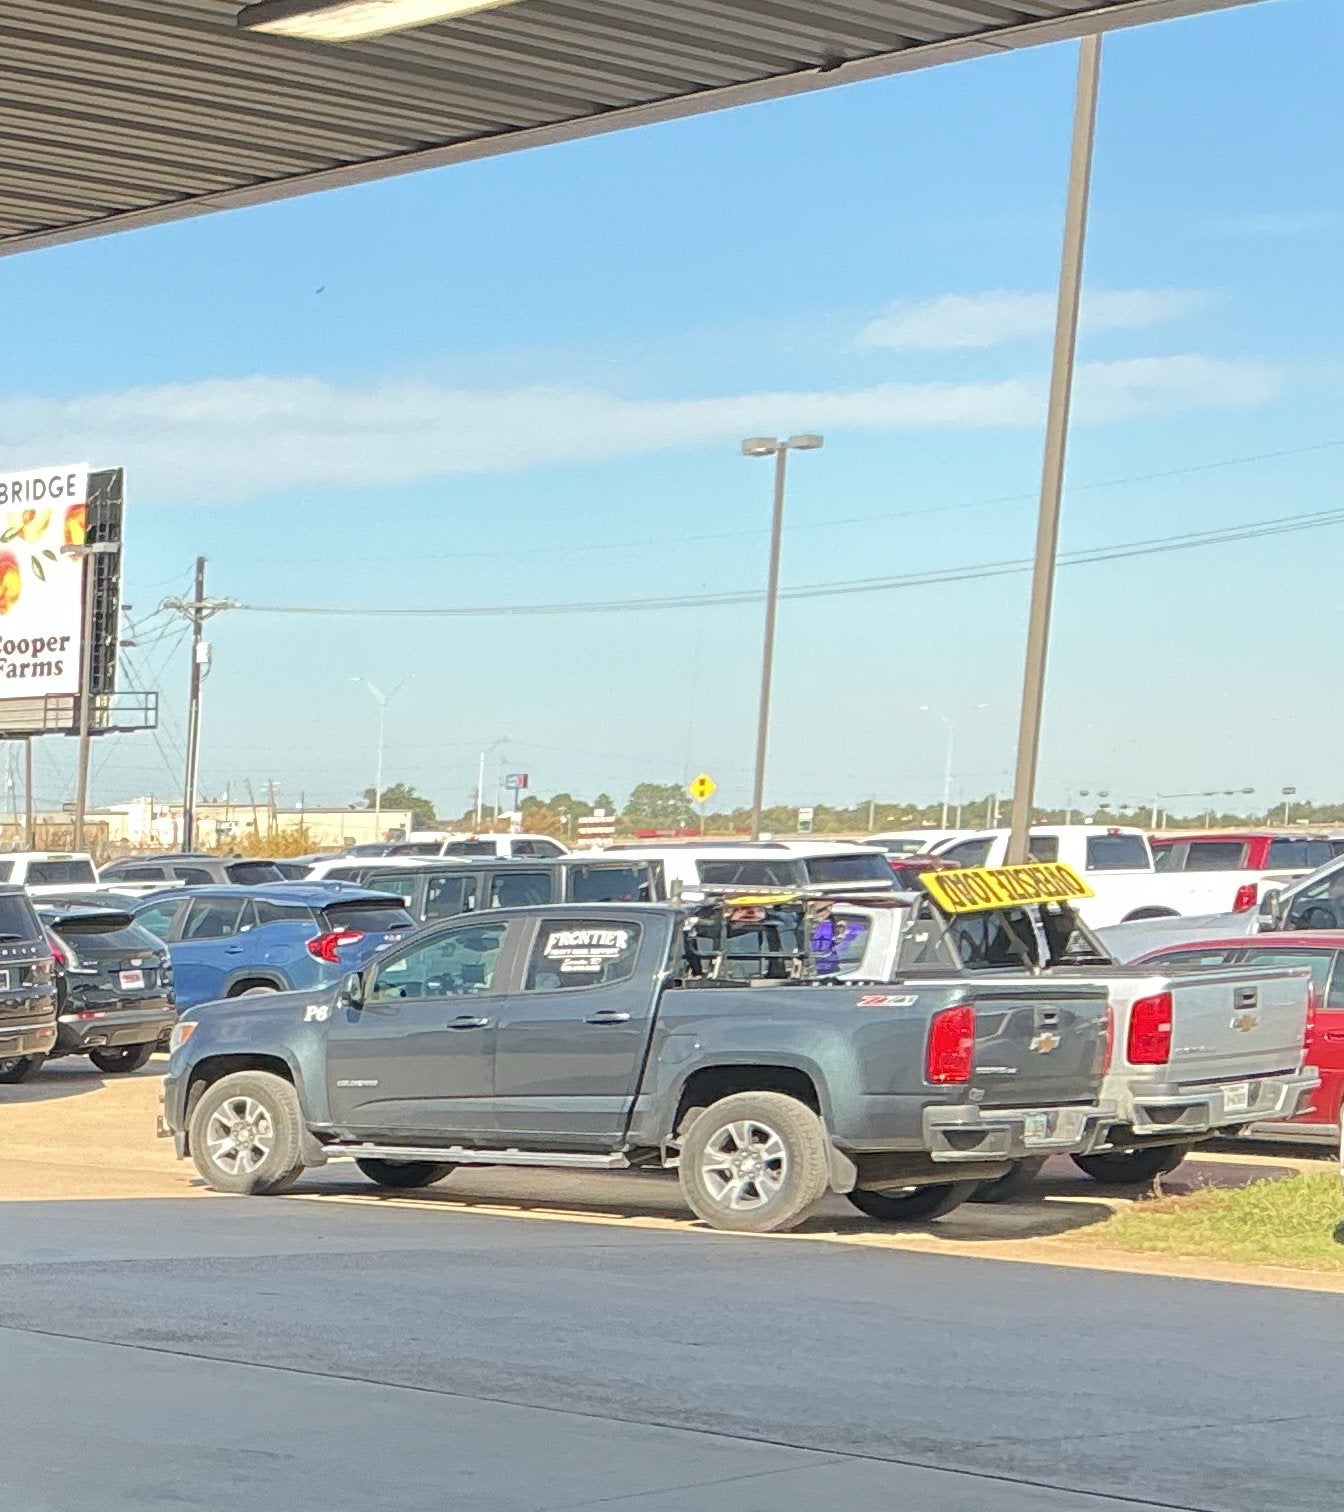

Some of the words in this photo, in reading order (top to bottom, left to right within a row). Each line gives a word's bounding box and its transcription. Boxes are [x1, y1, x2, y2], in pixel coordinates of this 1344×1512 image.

[934, 872, 1004, 908] LOAD
[987, 865, 1086, 901] OVERSIZE
[544, 930, 628, 955] FRONTIER
